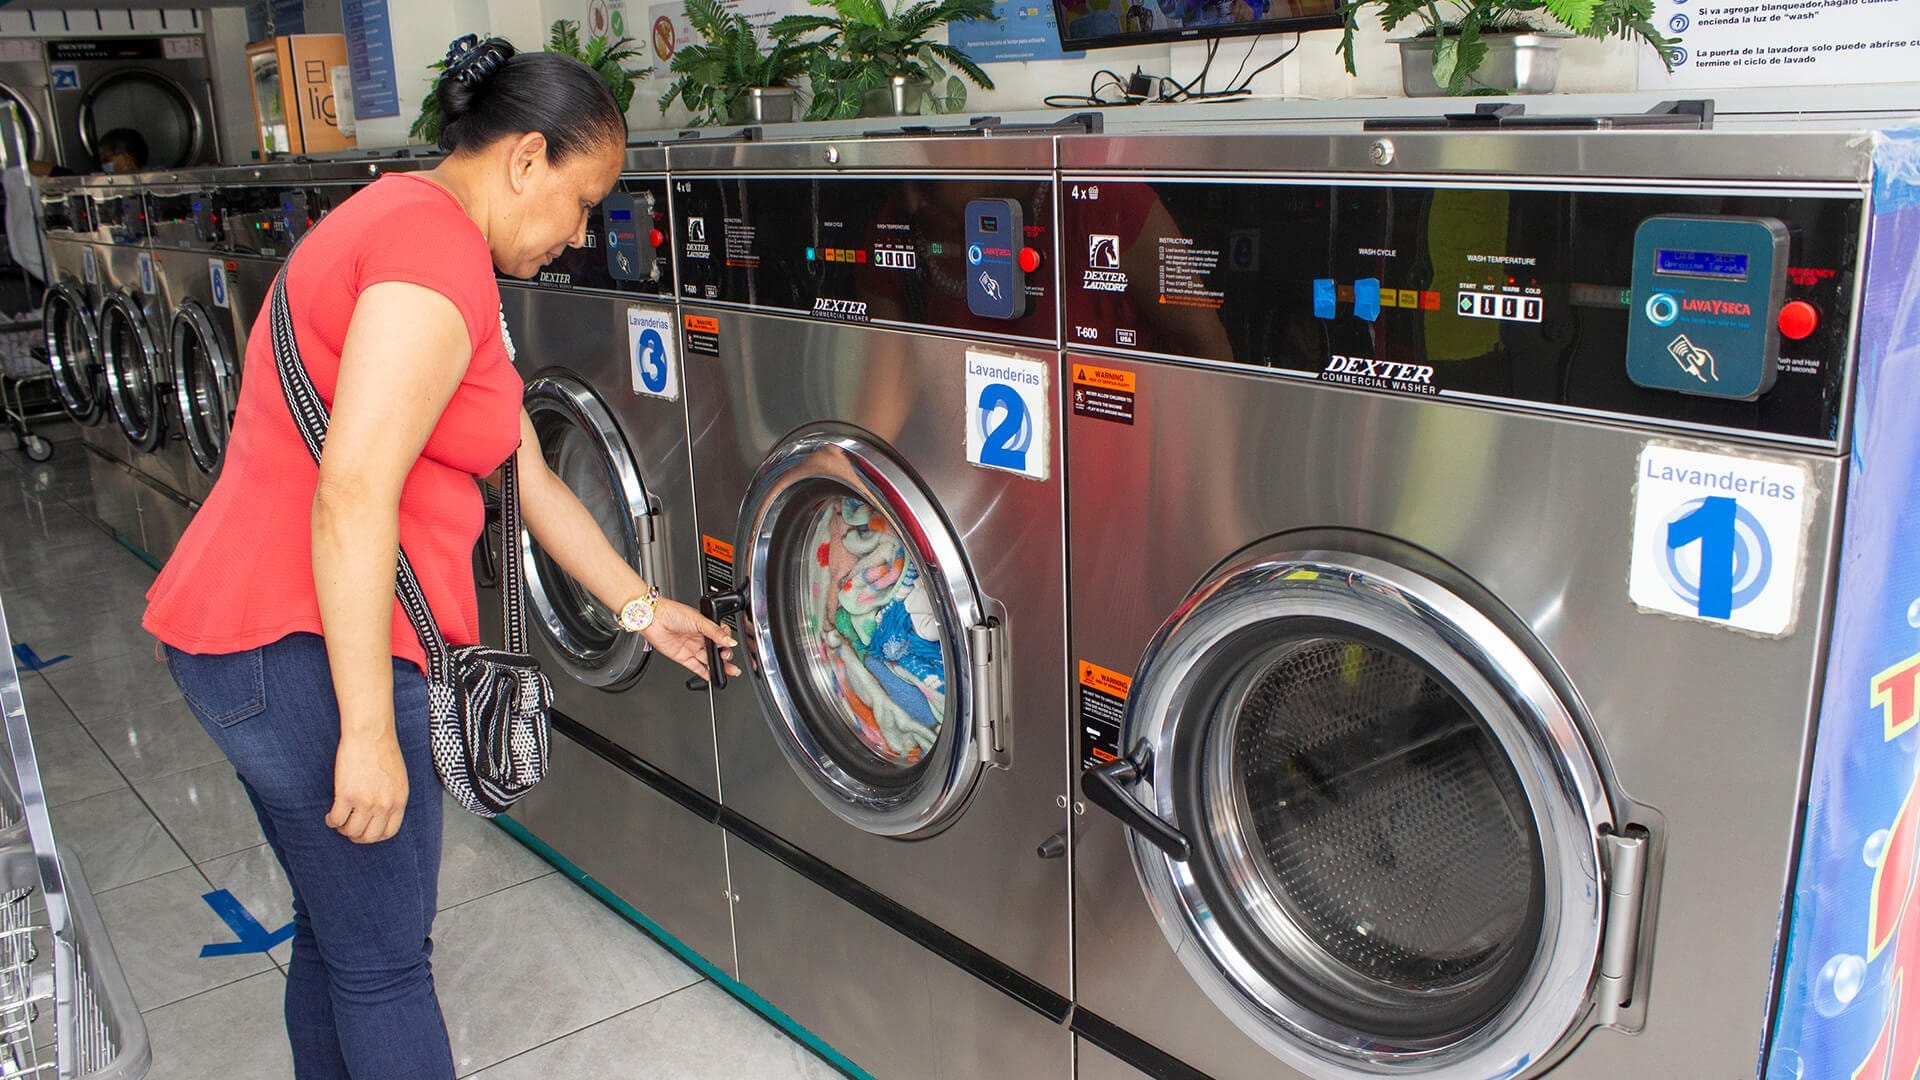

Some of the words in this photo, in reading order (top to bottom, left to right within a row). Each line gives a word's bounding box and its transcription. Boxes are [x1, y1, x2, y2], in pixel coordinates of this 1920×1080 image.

[1723, 6, 1759, 15] agregar
[1676, 20, 1680, 28] 7
[1698, 17, 1740, 26] encienda
[1742, 16, 1750, 24] la
[1710, 48, 1740, 57] puerta
[1742, 47, 1754, 55] de
[1768, 45, 1808, 54] lavadora
[1812, 44, 1832, 52] solo
[1835, 42, 1866, 51] puede
[1870, 40, 1907, 49] abrirse
[1696, 58, 1730, 67] termine
[53, 68, 77, 89] 21
[1072, 185, 1079, 199] 4
[1081, 190, 1086, 199] x
[1488, 256, 1536, 265] TEMPERATURE
[212, 266, 225, 305] 6
[540, 272, 571, 284] DEXTER
[1083, 281, 1127, 292] LAUNDRY
[813, 297, 867, 315] DEXTER
[1076, 326, 1098, 339] T-600
[639, 329, 667, 393] 3
[1325, 355, 1434, 383] DEXTER
[969, 361, 1039, 385] Lavanderías
[1095, 371, 1124, 382] WARNING
[1321, 372, 1388, 388] COMMERCIAL
[1392, 381, 1436, 394] WASHER
[979, 383, 1026, 471] 2
[1647, 459, 1796, 500] Lavanderías
[1668, 496, 1736, 620] 1
